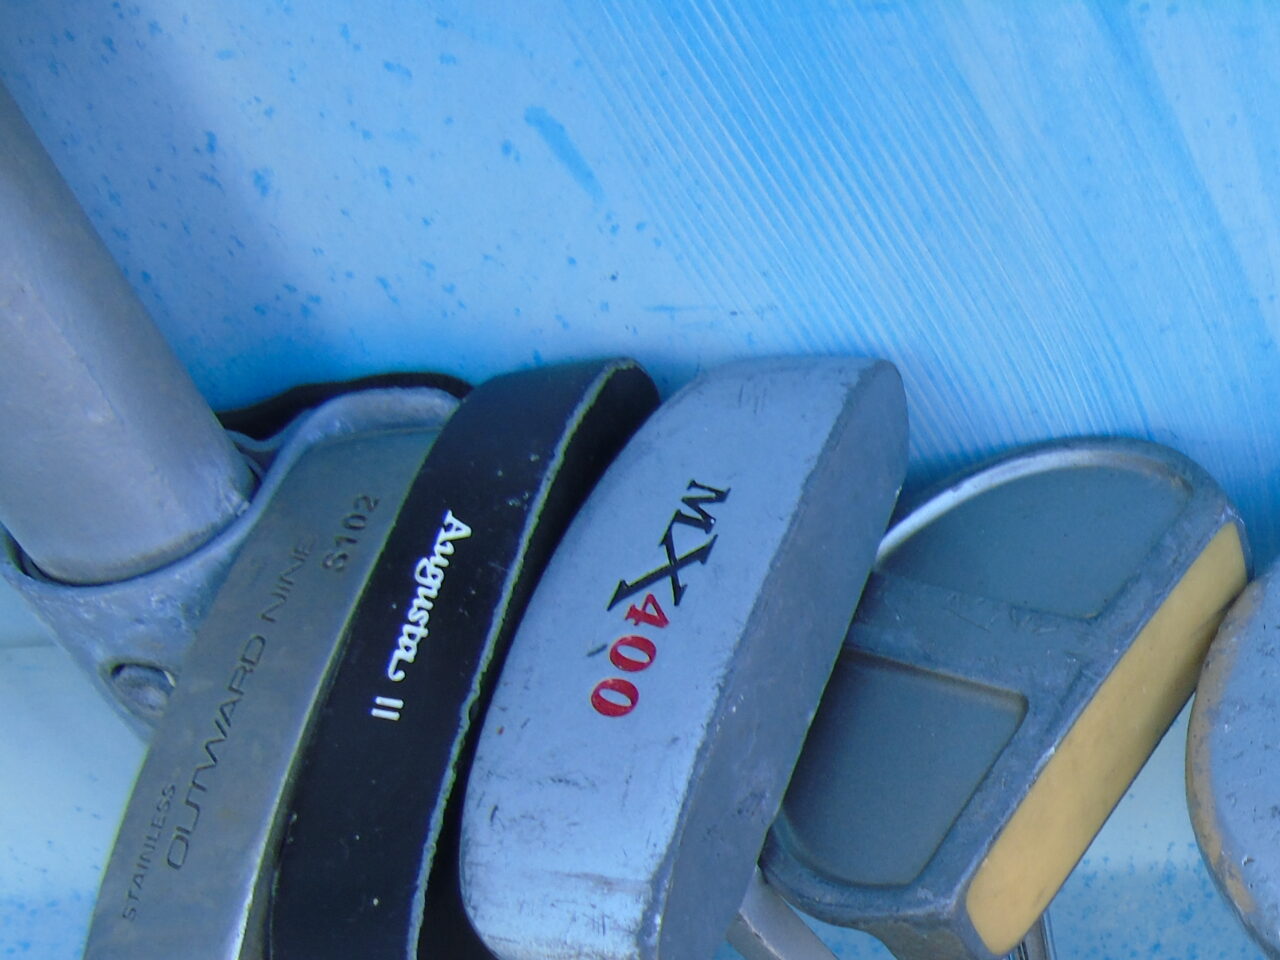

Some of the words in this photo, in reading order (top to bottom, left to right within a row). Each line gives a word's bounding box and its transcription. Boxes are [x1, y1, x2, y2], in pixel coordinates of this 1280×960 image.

[388, 509, 472, 681] Augusta
[606, 479, 731, 612] MX
[167, 634, 266, 870] OUTWARD
[259, 533, 316, 623] NINE
[590, 593, 670, 717] 400
[122, 783, 176, 922] STAINLESS
